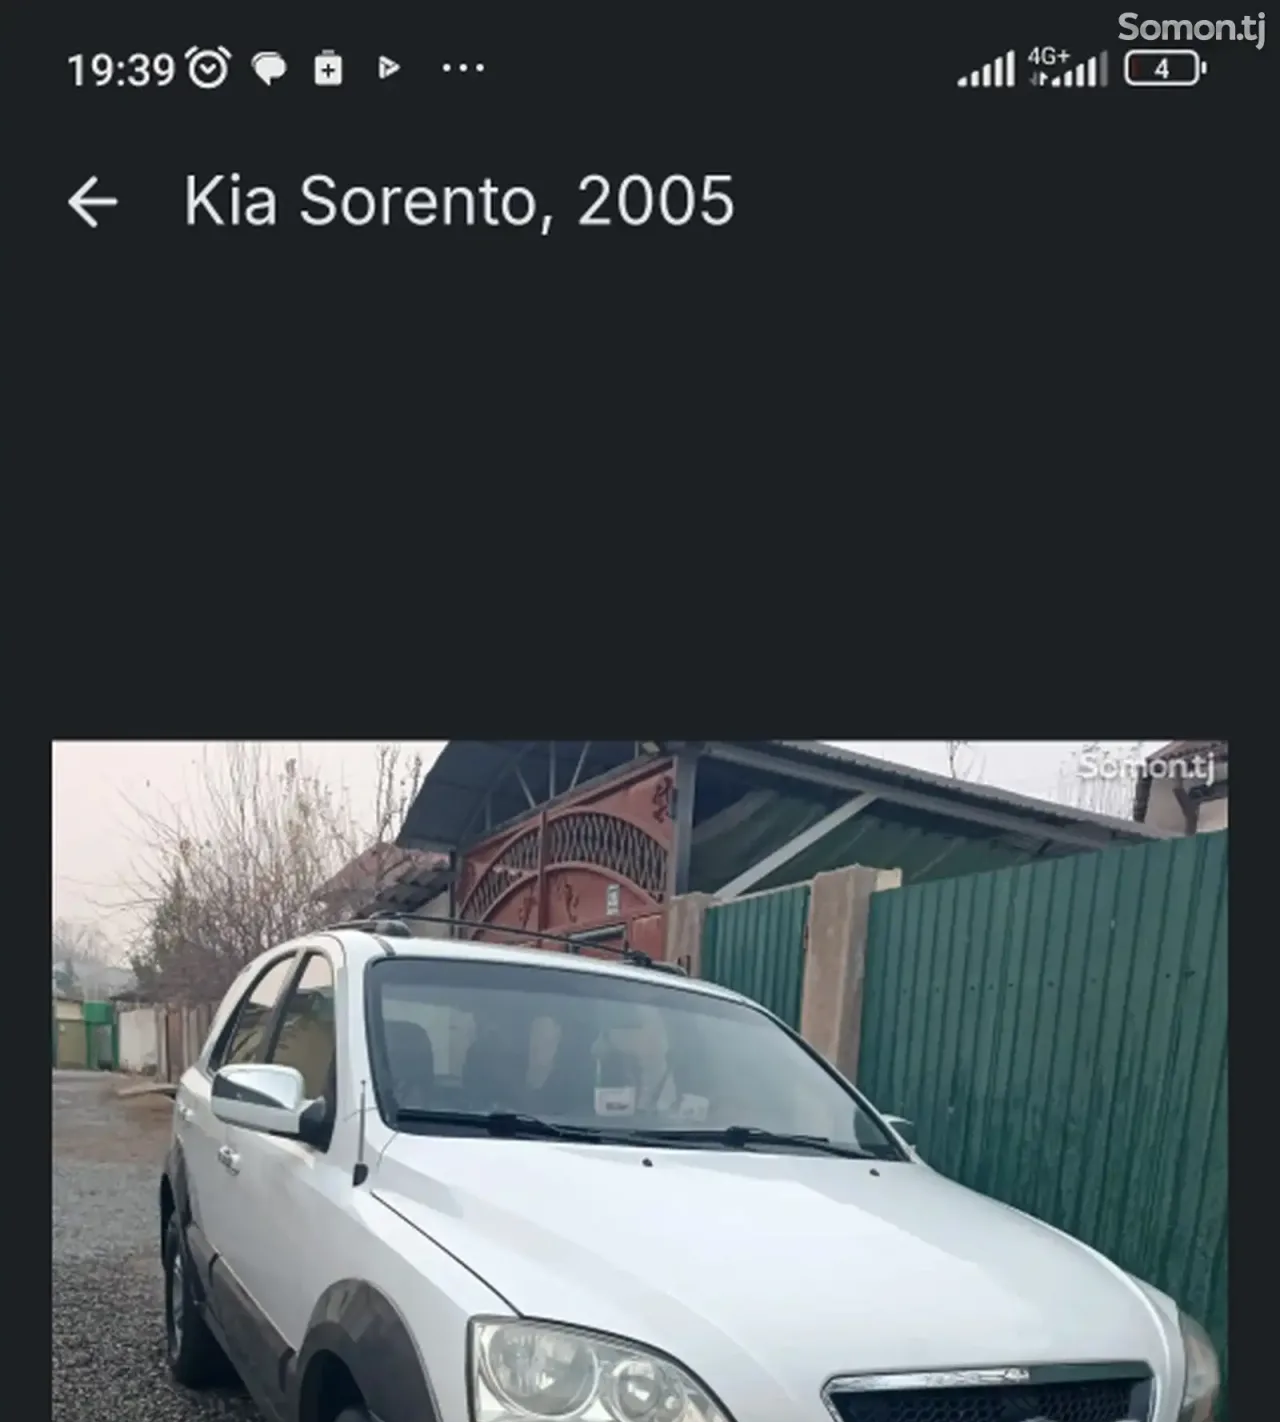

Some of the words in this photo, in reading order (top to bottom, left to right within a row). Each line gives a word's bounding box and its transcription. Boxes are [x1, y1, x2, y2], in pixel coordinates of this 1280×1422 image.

[67, 52, 176, 88] 19:39
[1027, 46, 1071, 66] 4G+
[1153, 57, 1170, 79] 4
[186, 173, 276, 226] Kia
[300, 173, 553, 236] Sorento,
[578, 173, 734, 227] 2005
